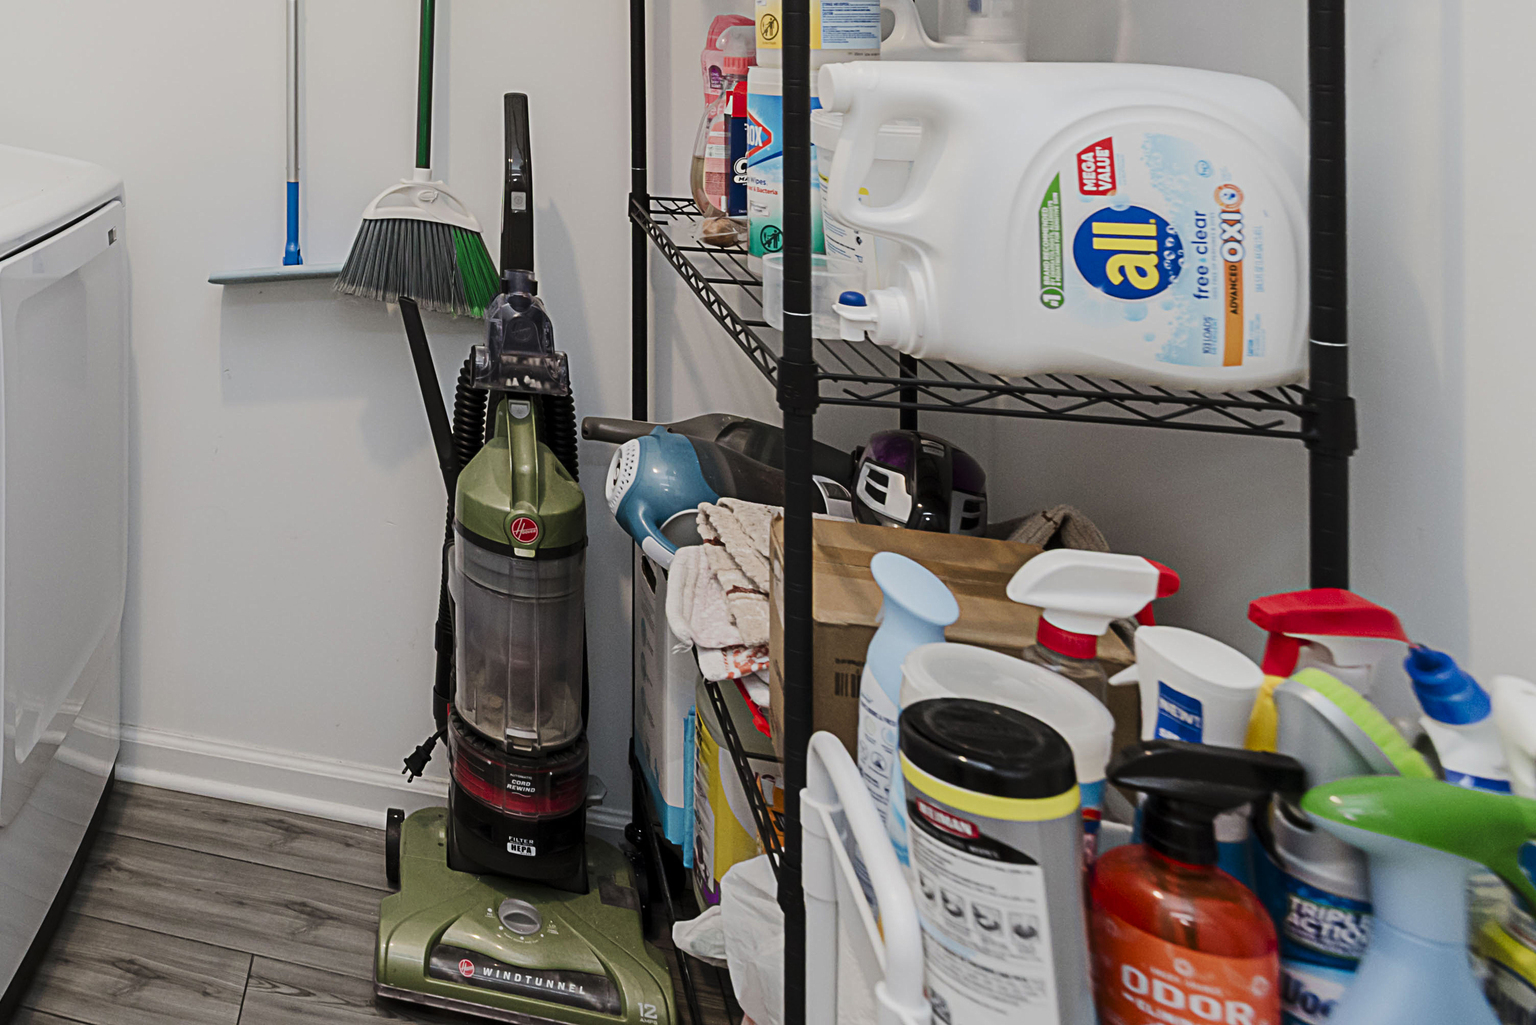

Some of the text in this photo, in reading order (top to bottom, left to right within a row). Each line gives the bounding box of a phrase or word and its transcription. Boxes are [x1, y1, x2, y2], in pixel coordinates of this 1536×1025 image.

[1081, 151, 1098, 191] MEGA
[1041, 207, 1050, 260] RECOMMENDED
[1219, 211, 1246, 263] OXI
[1191, 210, 1209, 300] free clear
[1230, 264, 1238, 315] ADVANCED
[506, 783, 536, 793] REWIND
[511, 779, 531, 787] CORD
[508, 835, 534, 844] FILTER
[511, 843, 532, 854] HEPA
[482, 967, 586, 995] WINDTUNNEL
[1120, 963, 1256, 1025] ODOR
[638, 1002, 658, 1020] 12
